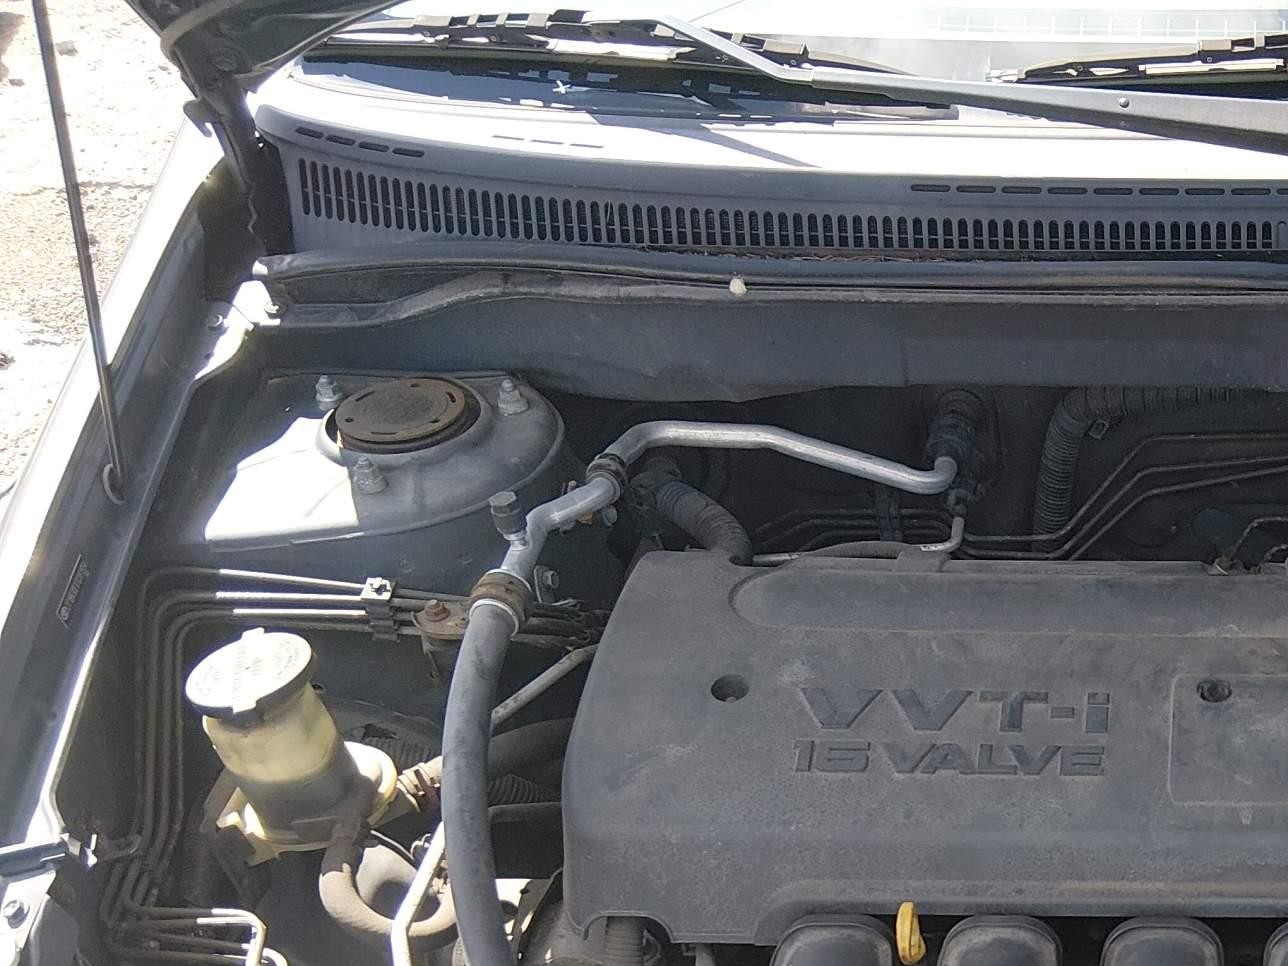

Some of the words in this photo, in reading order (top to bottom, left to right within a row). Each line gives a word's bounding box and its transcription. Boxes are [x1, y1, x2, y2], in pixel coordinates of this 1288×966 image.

[799, 687, 1111, 734] VVT-i
[794, 740, 872, 774] 16
[880, 742, 1106, 777] VALVE
